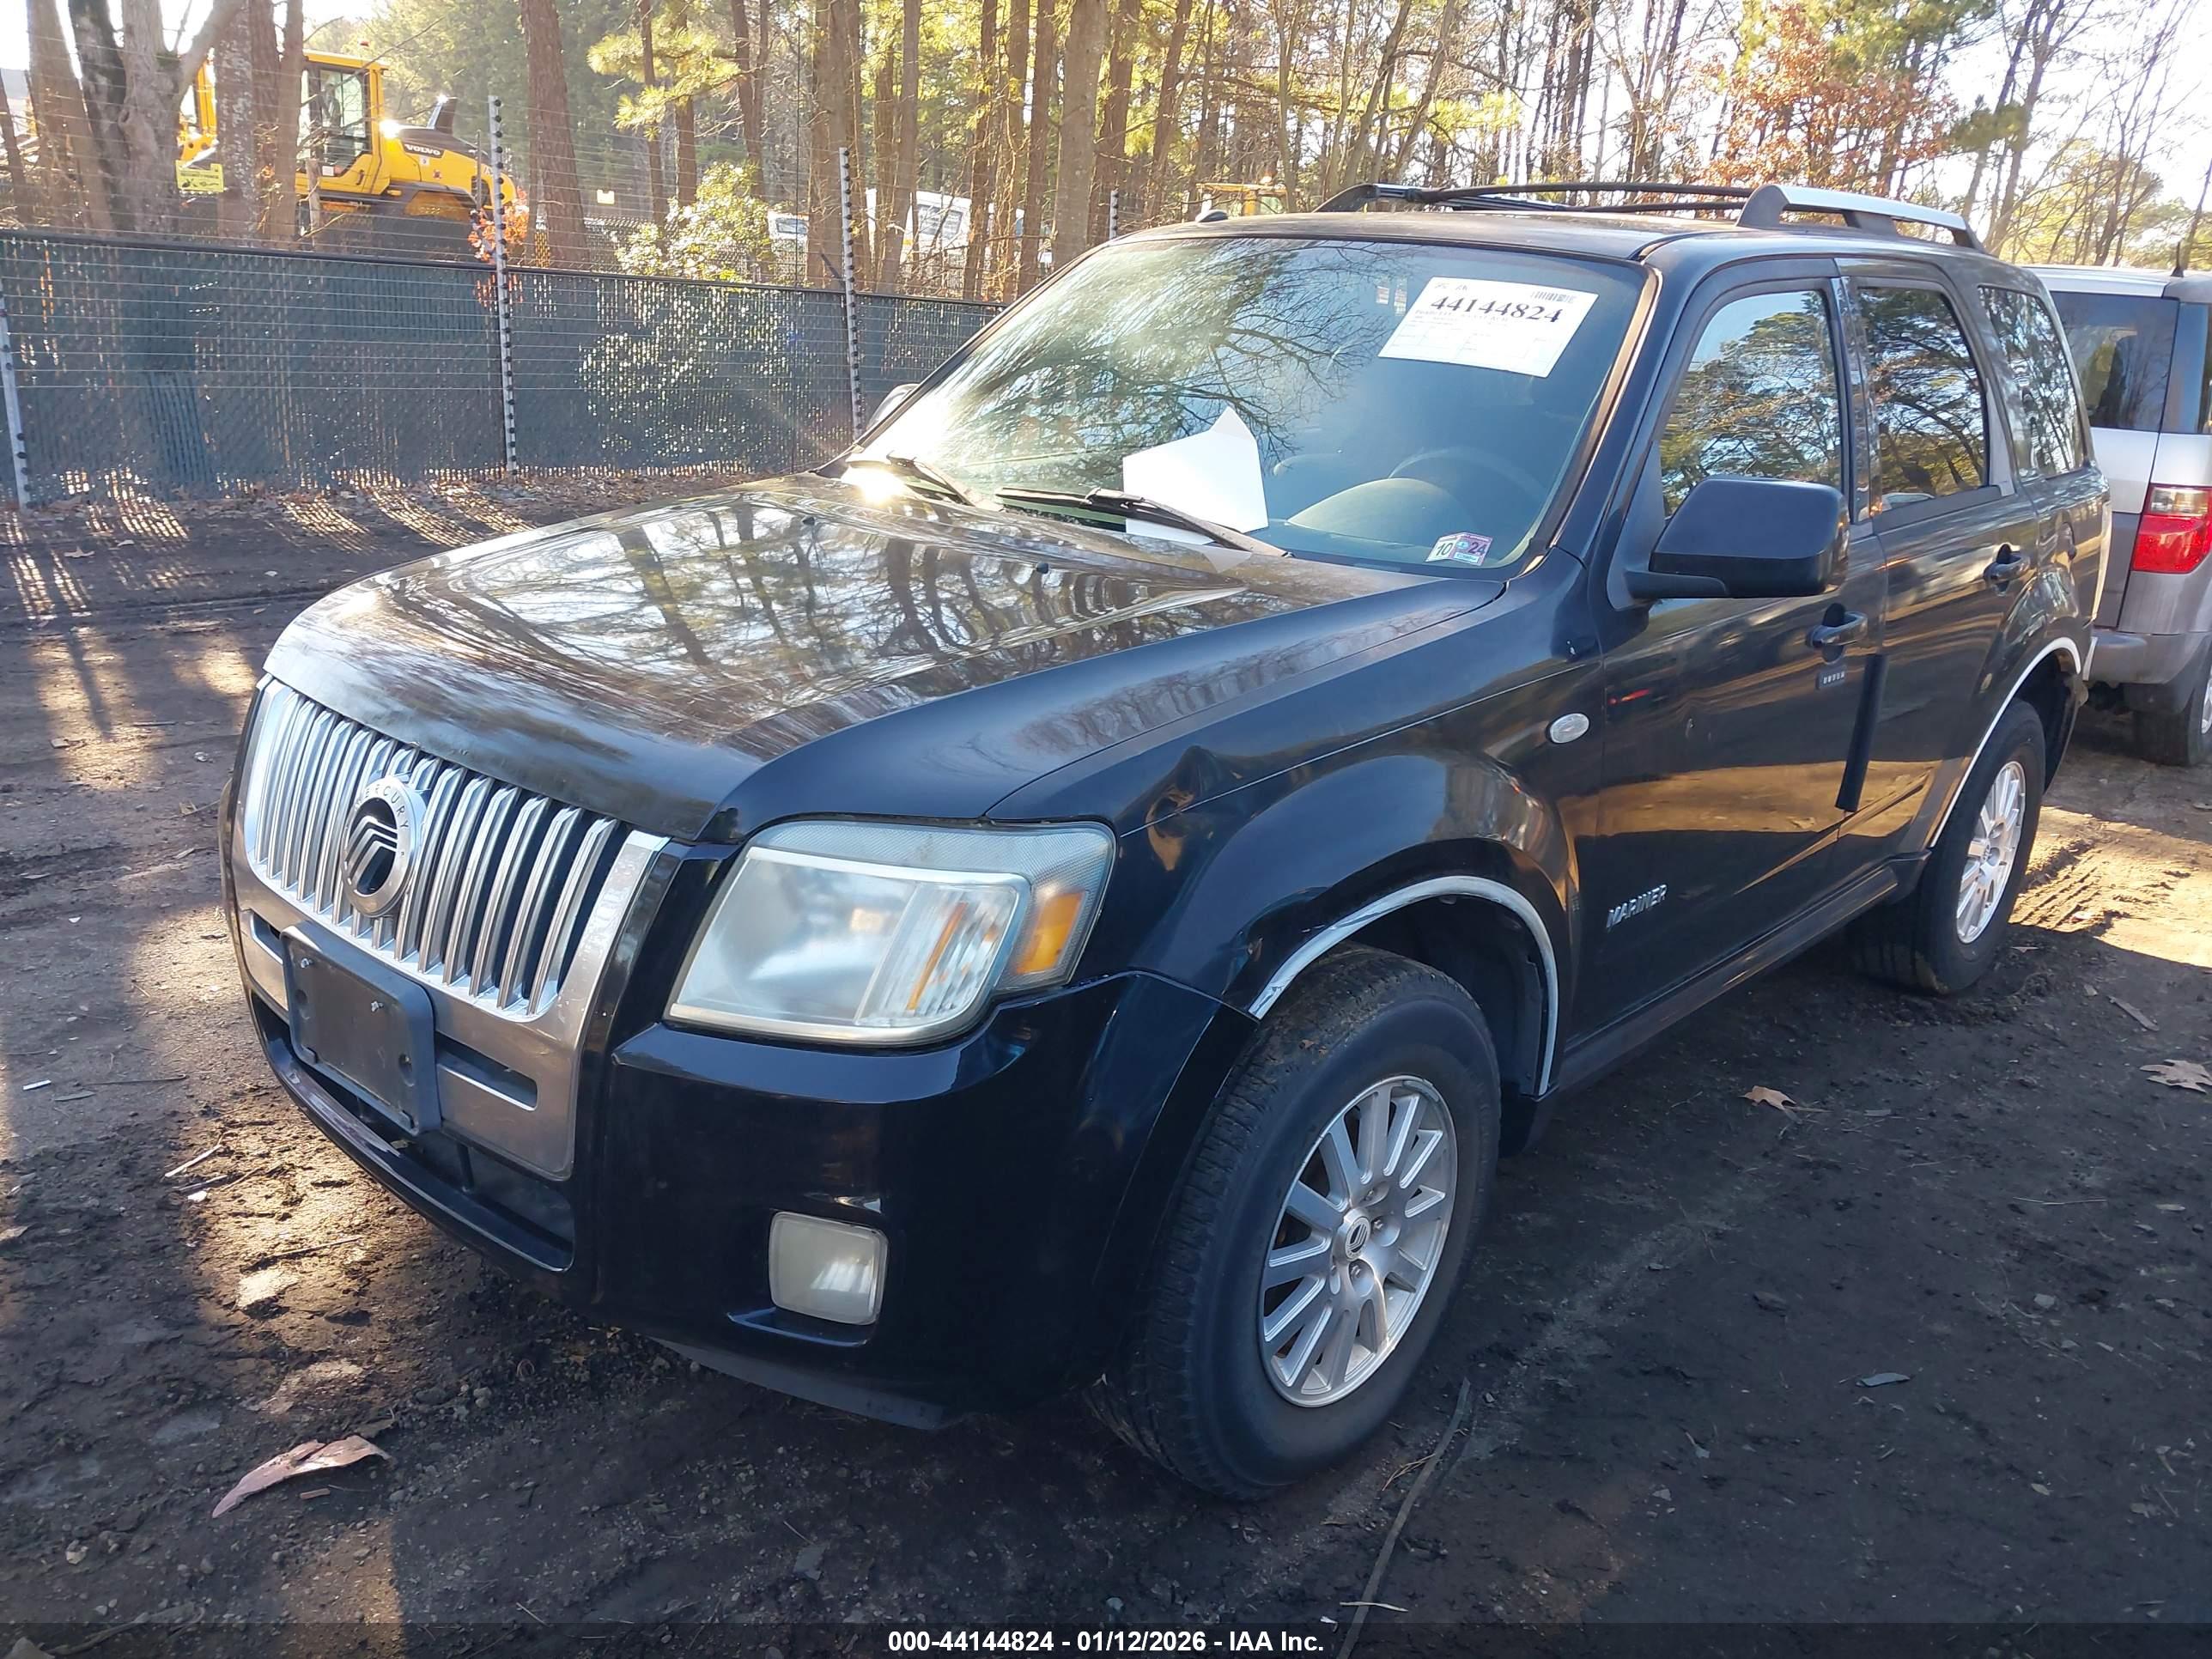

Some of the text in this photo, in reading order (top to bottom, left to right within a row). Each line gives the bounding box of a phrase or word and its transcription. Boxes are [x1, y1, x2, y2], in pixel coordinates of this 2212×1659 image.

[404, 143, 441, 155] VOLVO
[1431, 295, 1564, 323] 44144824
[1436, 541, 1487, 556] 10 24
[1606, 884, 1668, 928] MARINER
